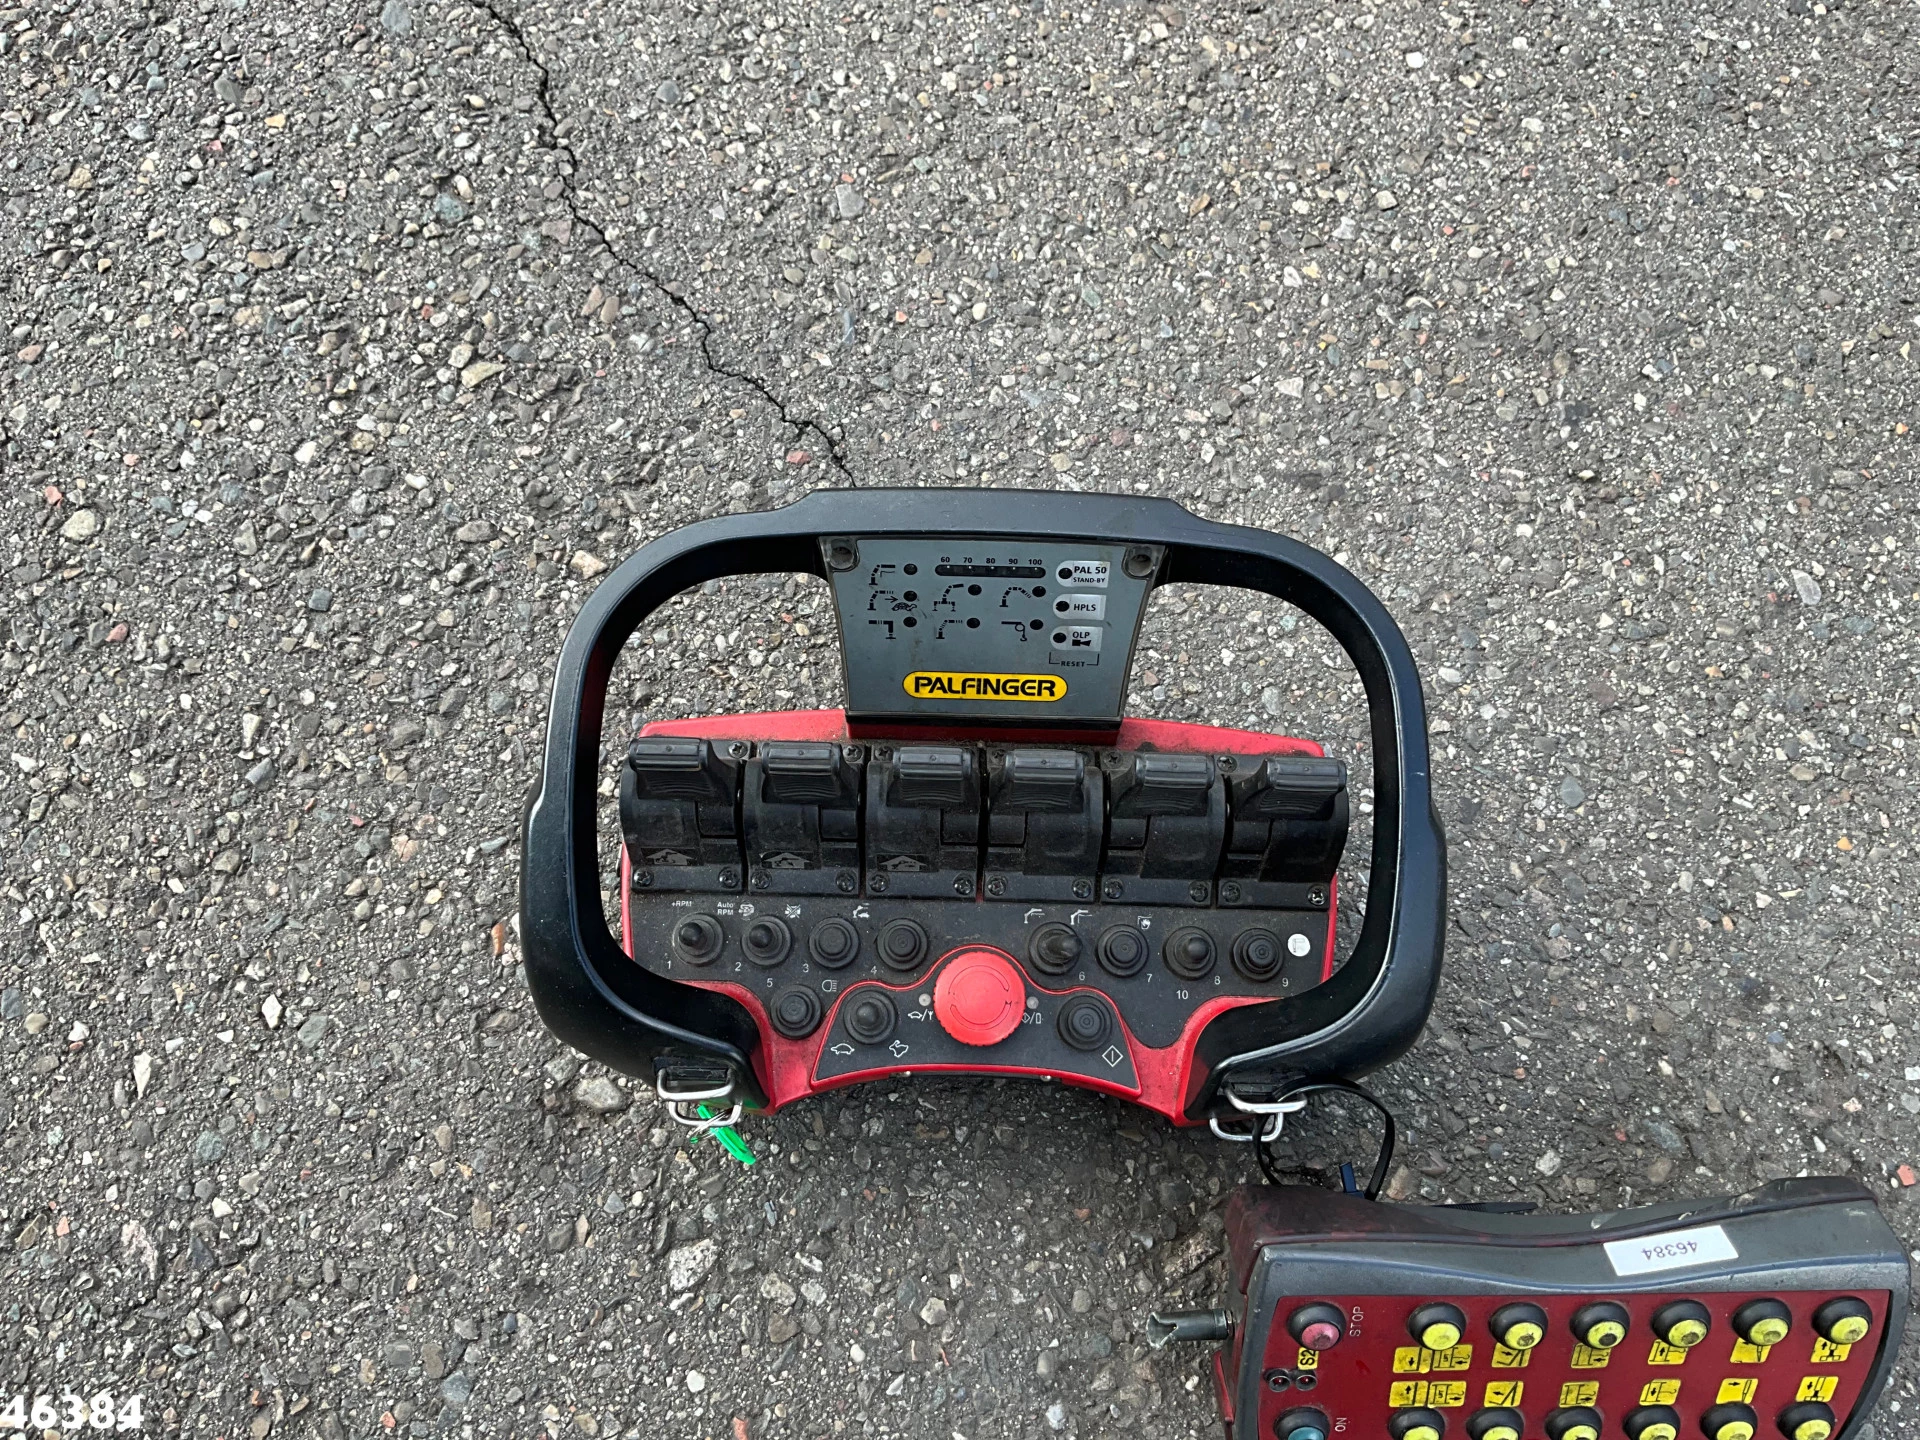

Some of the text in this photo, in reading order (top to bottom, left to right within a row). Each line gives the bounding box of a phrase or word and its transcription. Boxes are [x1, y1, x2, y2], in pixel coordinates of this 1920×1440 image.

[1028, 558, 1042, 566] 100
[1073, 565, 1107, 575] PAL 50
[1072, 576, 1106, 584] STAND-BY
[1073, 603, 1096, 612] HPLS
[1072, 631, 1090, 639] OLP
[1060, 660, 1085, 668] RESET
[914, 676, 1056, 697] PALFINGER
[717, 908, 734, 916] RPM
[666, 960, 672, 969] 1
[734, 962, 742, 971] 2
[802, 963, 809, 973] 3
[870, 965, 877, 975] 4
[1078, 971, 1086, 981] 6
[1146, 974, 1153, 983] 7
[1214, 976, 1221, 985] 8
[766, 978, 773, 988] 5
[1282, 977, 1289, 987] 9
[1176, 990, 1189, 1000] 10
[1641, 1240, 1698, 1261] 46384
[1349, 1306, 1364, 1337] STOP
[1334, 1417, 1347, 1432] ON
